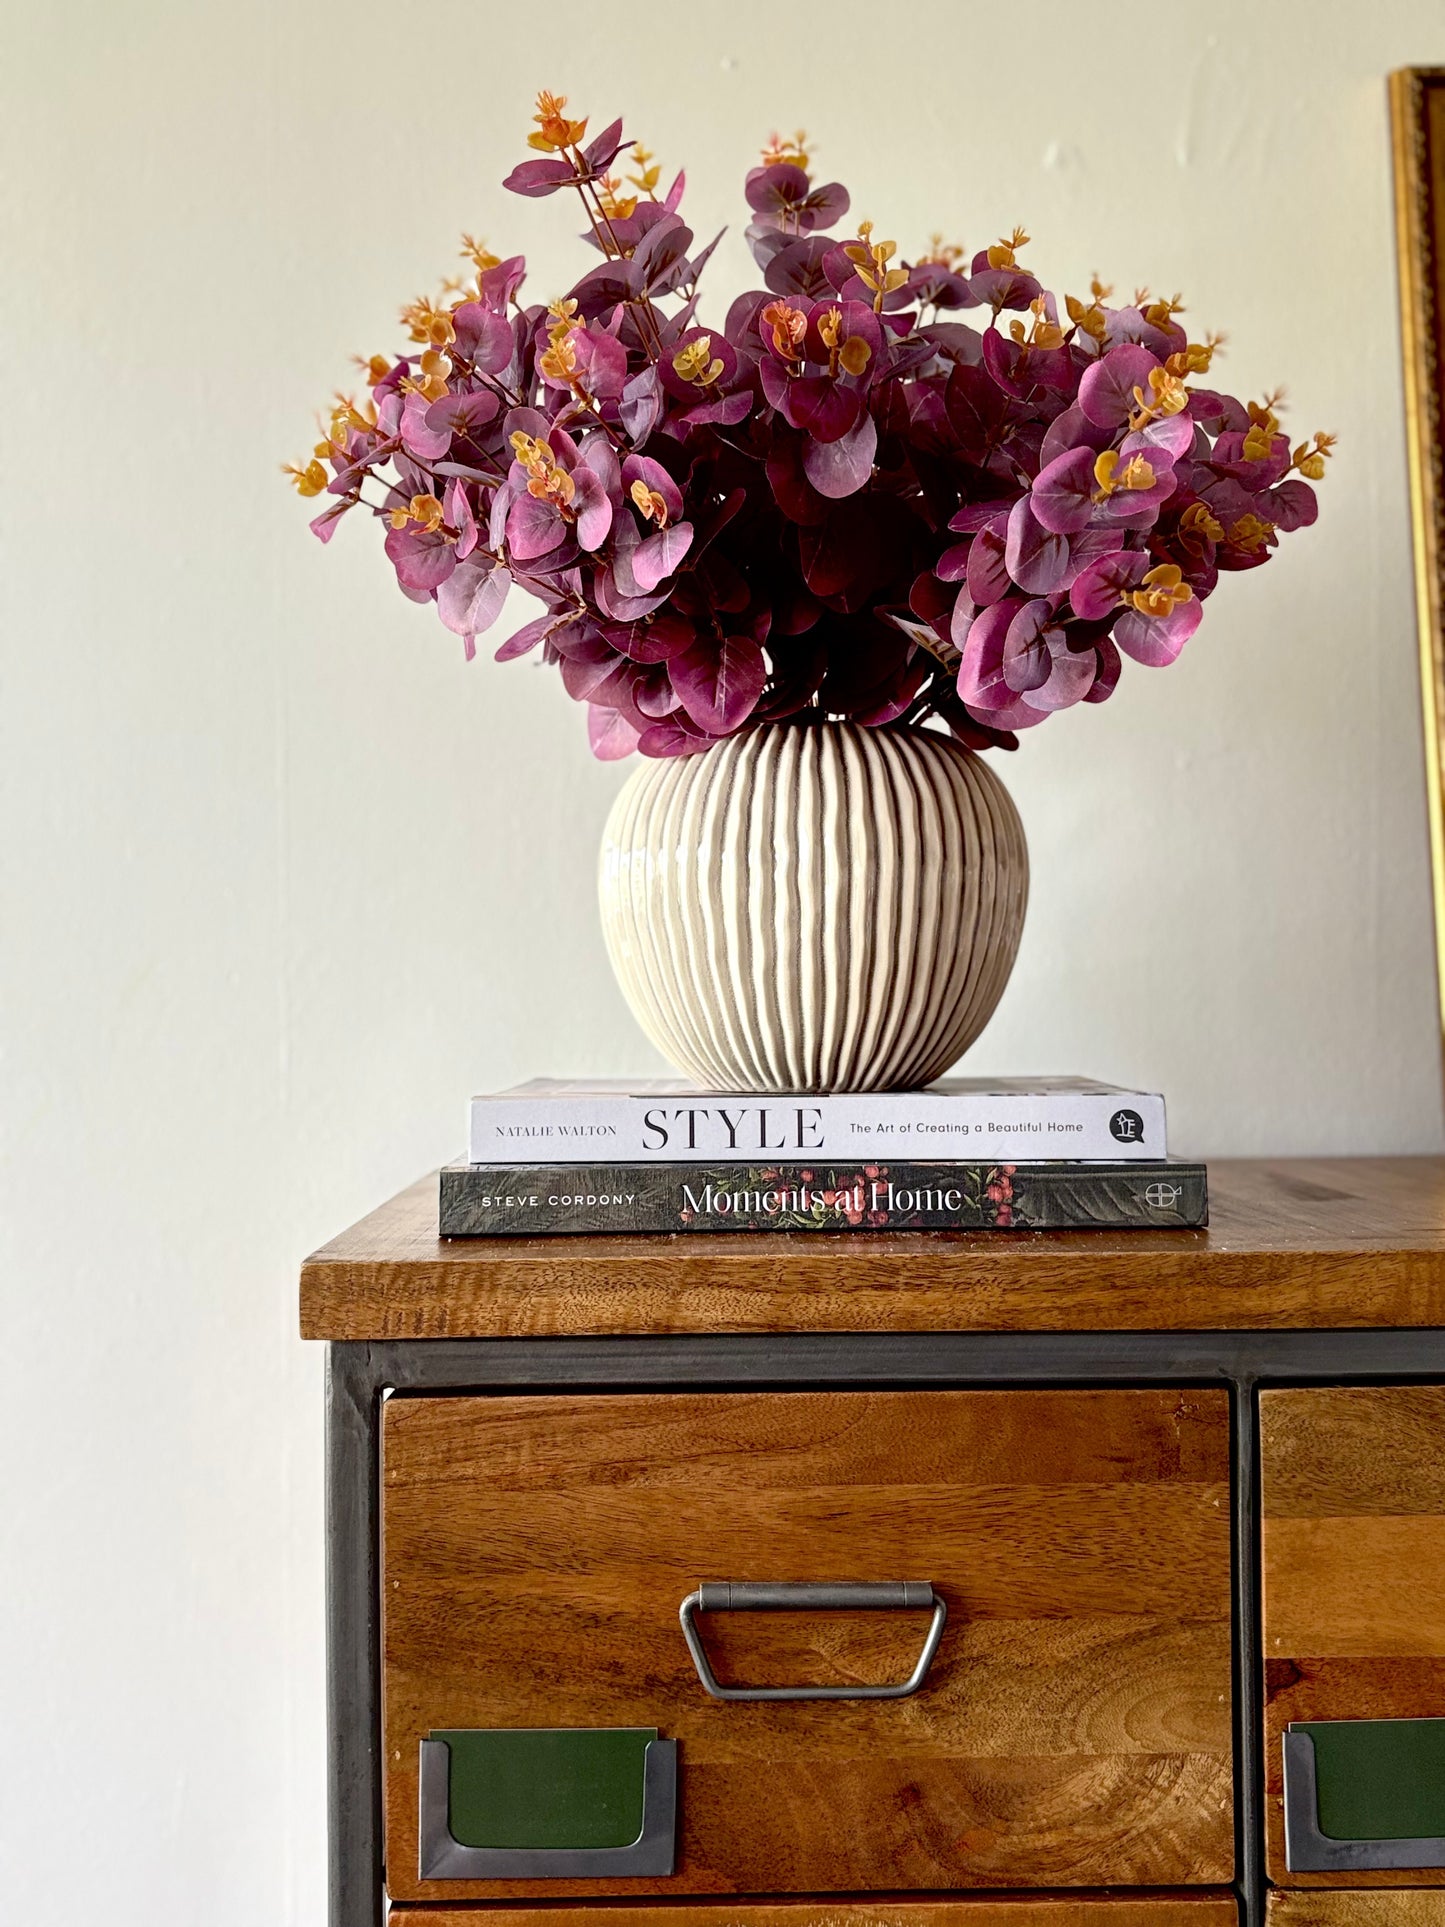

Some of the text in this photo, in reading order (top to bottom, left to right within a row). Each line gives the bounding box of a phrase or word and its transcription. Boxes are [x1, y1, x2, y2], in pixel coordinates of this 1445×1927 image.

[495, 1125, 617, 1137] NATALIE WALTON
[642, 1108, 825, 1150] STYLE
[850, 1122, 1083, 1135] The Art of Creating a Beautiful Home
[481, 1194, 635, 1207] STEVE CORDONY
[681, 1183, 962, 1213] Moments at Home
